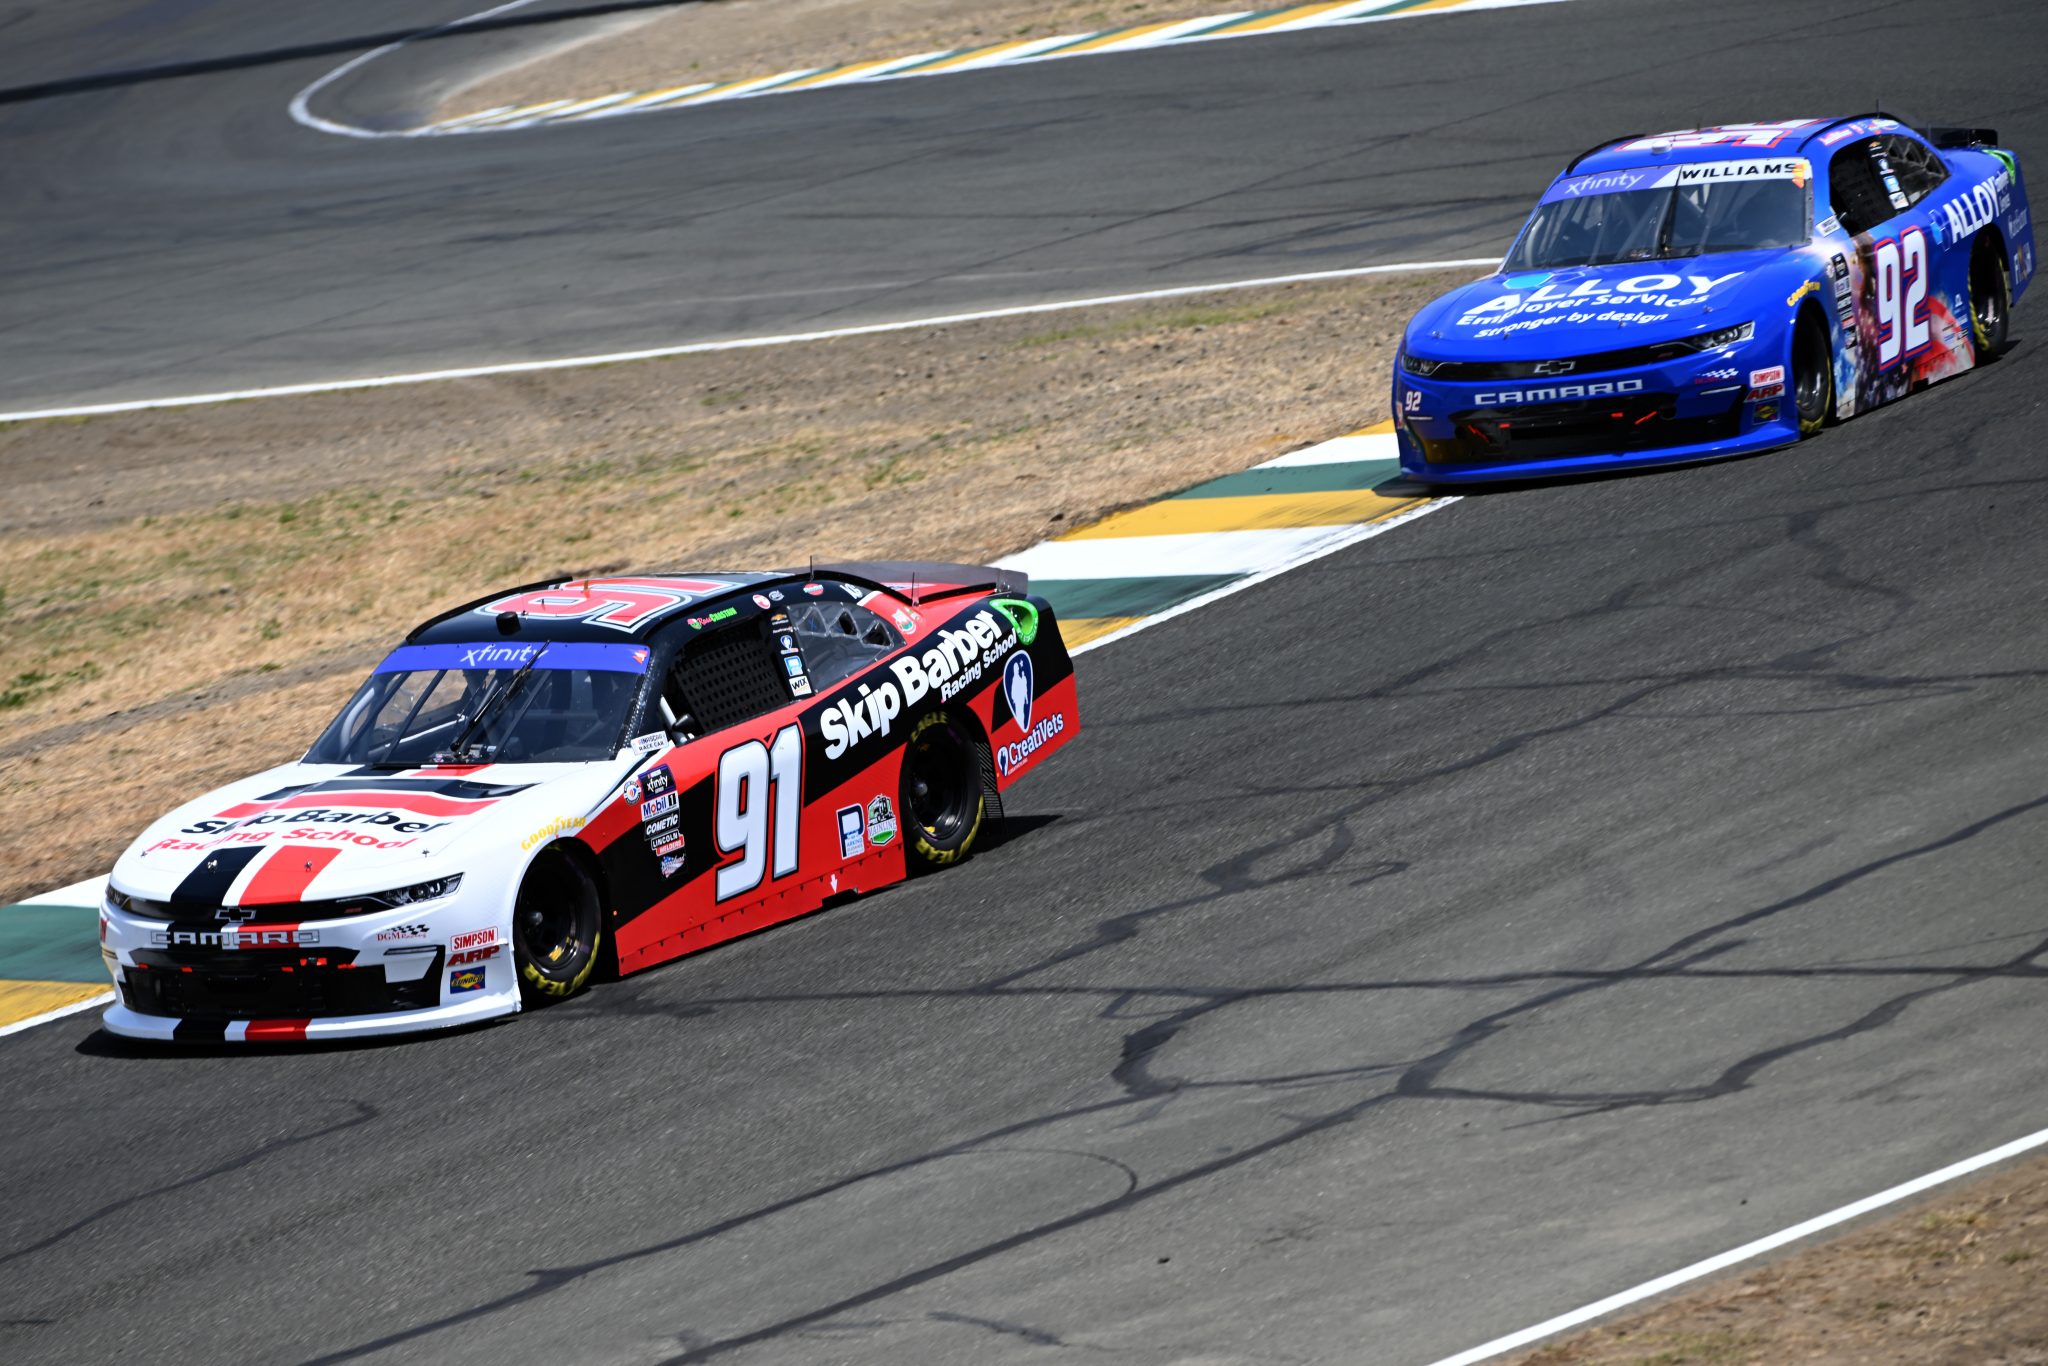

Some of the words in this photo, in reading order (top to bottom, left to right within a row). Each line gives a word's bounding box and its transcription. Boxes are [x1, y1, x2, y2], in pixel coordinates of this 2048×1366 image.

[1682, 163, 1800, 180] WILLIAMS
[1564, 174, 1645, 195] xfinity
[1942, 176, 1999, 244] ALLOY
[1463, 271, 1746, 315] ALLOY
[1875, 226, 1931, 369] 92
[1456, 297, 1592, 326] Employer
[1592, 293, 1710, 308] Services
[1566, 311, 1597, 323] by
[1597, 310, 1669, 325] design
[1405, 390, 1422, 411] 92
[1475, 379, 1643, 405] CAMARO
[460, 644, 549, 667] xfinity
[941, 660, 982, 702] Racing
[983, 627, 1017, 669] School
[792, 678, 807, 690] WIX
[820, 682, 900, 760] Skip
[889, 609, 1003, 708] Barber
[1008, 712, 1064, 766] CreatiVets
[647, 775, 668, 792] xfinity
[643, 796, 666, 817] Mobil
[715, 722, 802, 906] 91
[283, 809, 453, 833] Barber
[646, 814, 678, 836] COMETIC
[146, 830, 275, 853] Racing
[282, 828, 419, 849] School
[653, 832, 678, 847] LINCOLN
[151, 929, 320, 946] CAMARO
[376, 932, 401, 942] DGM
[454, 929, 495, 950] SIMPSON
[446, 945, 500, 968] ARP
